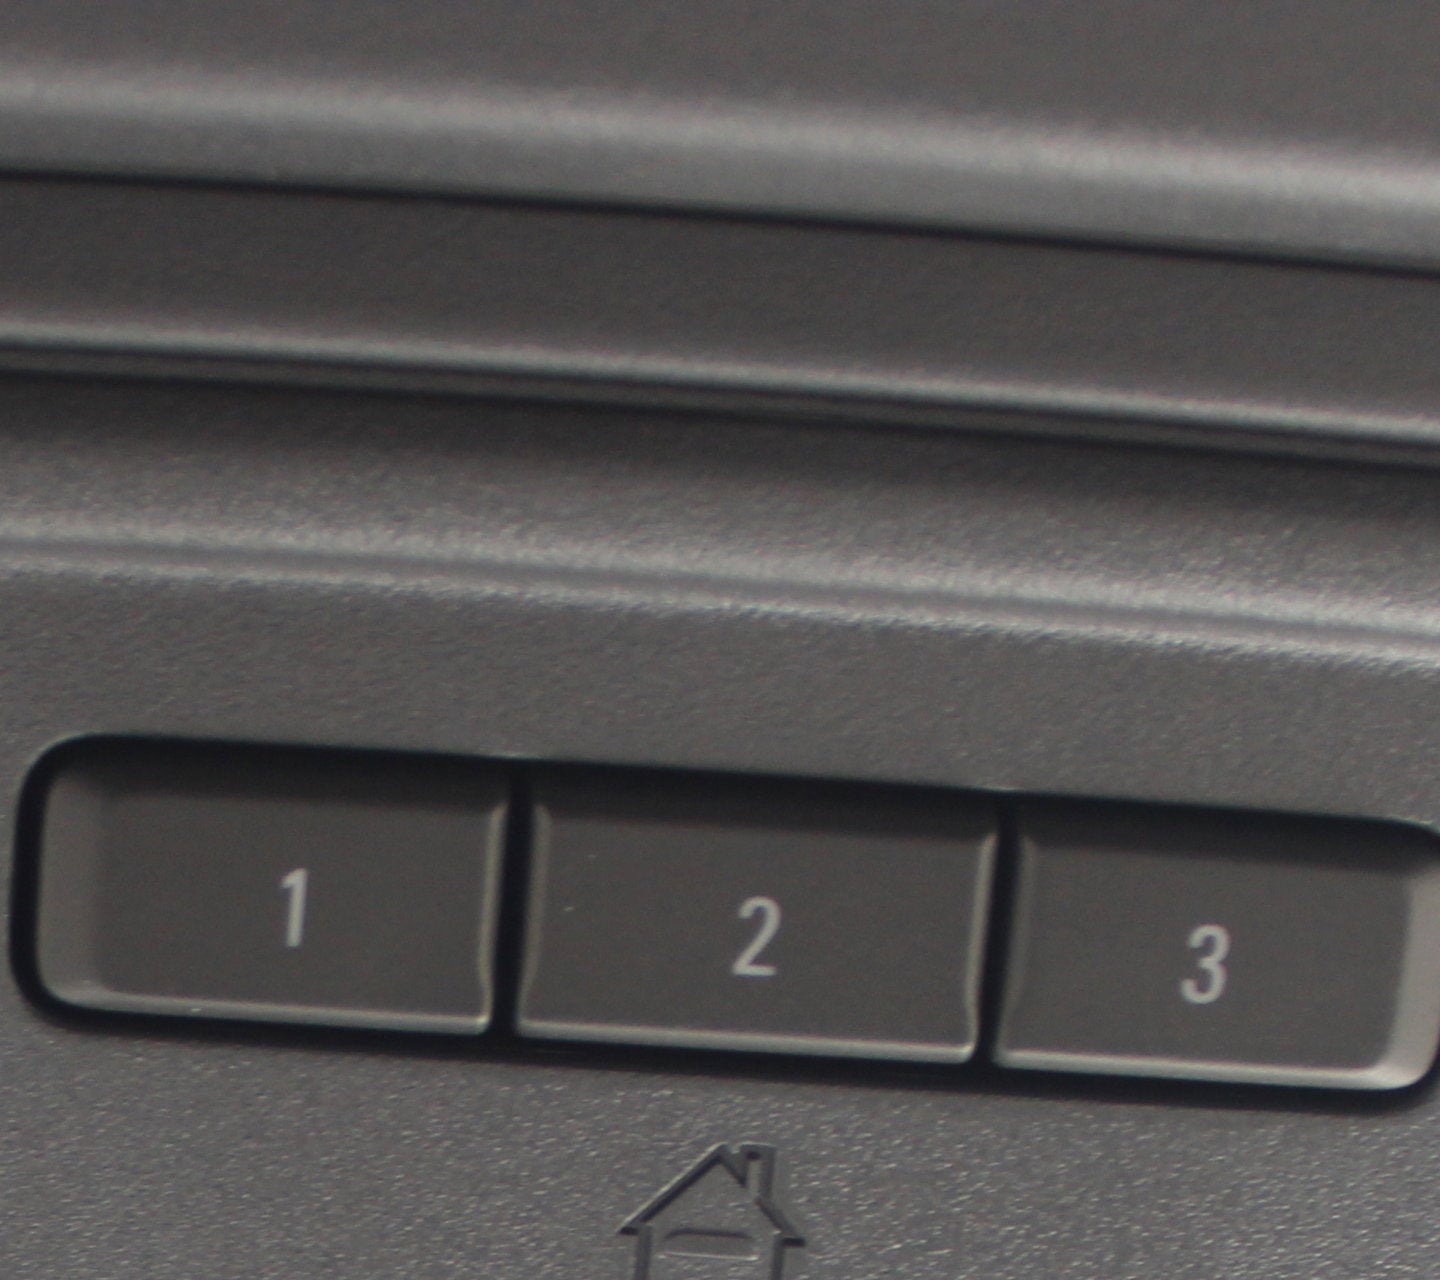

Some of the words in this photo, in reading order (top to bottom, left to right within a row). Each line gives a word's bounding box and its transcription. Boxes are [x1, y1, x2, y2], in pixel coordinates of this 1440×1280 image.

[279, 868, 310, 948] 1
[732, 896, 783, 977] 2
[1180, 925, 1230, 1004] 3
